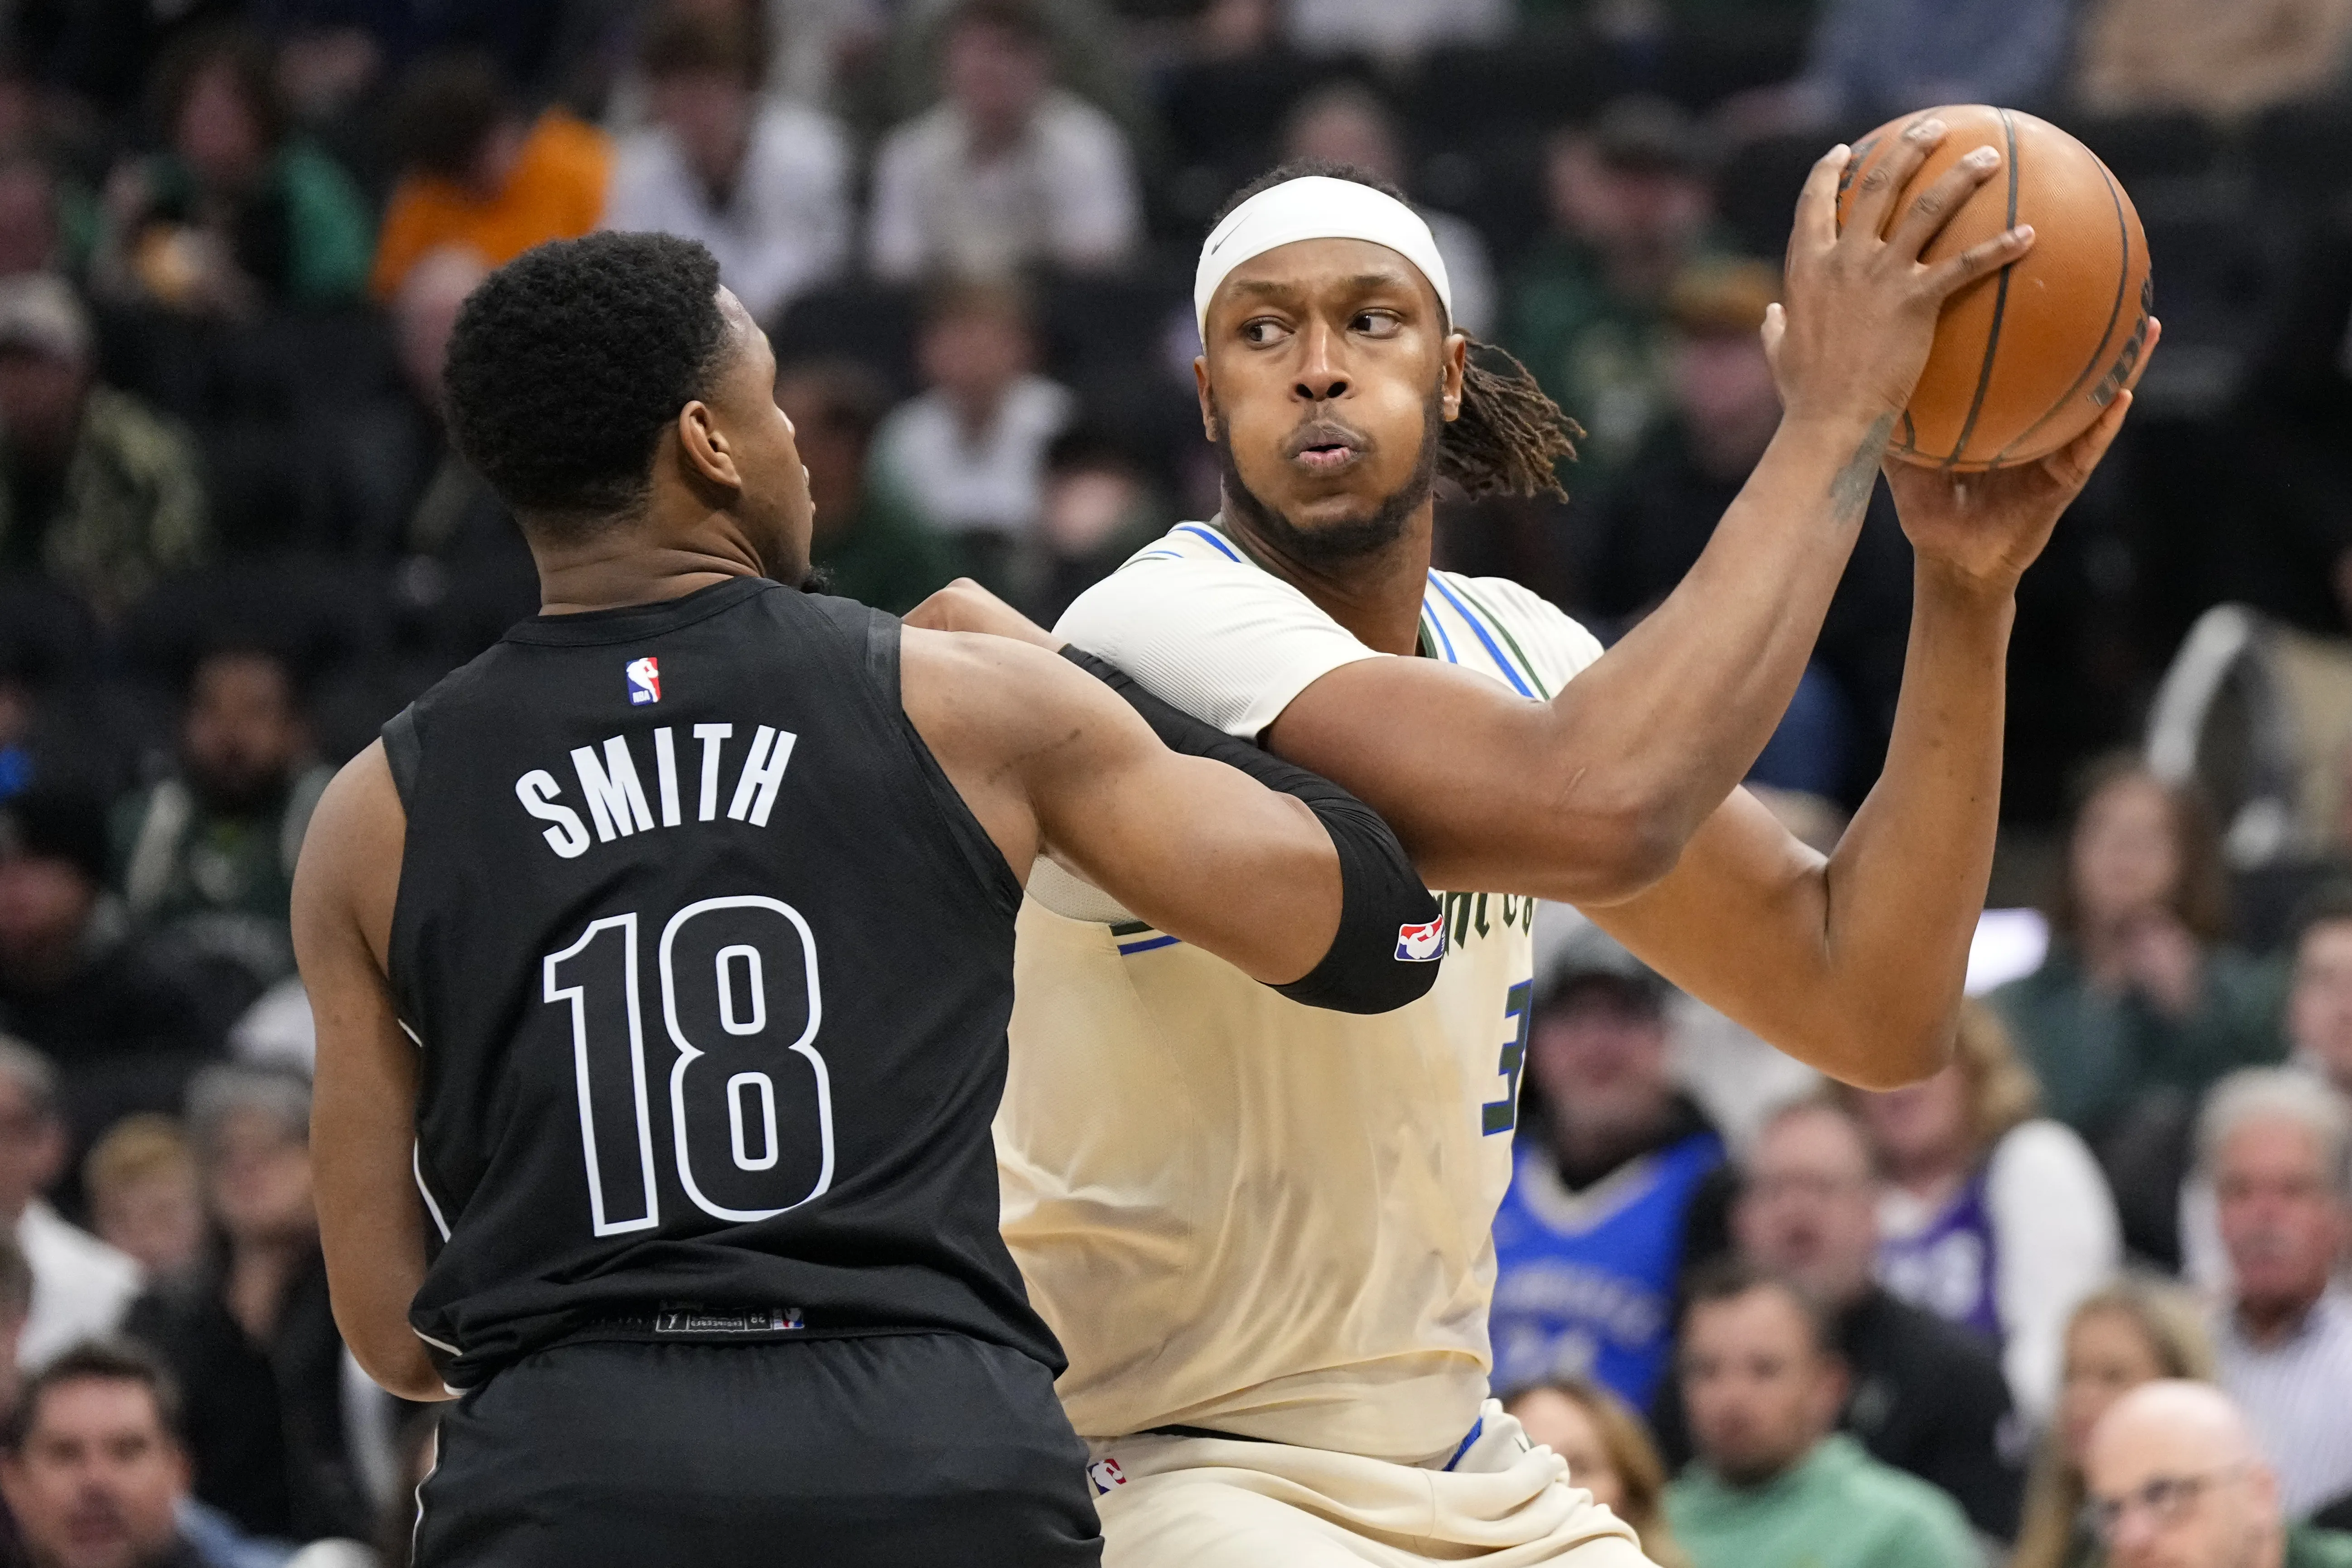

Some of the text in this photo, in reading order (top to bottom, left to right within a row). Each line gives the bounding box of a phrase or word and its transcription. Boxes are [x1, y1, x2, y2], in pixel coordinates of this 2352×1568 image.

[633, 690, 651, 703] NBA
[515, 723, 797, 859] SMITH
[544, 895, 835, 1237] 18
